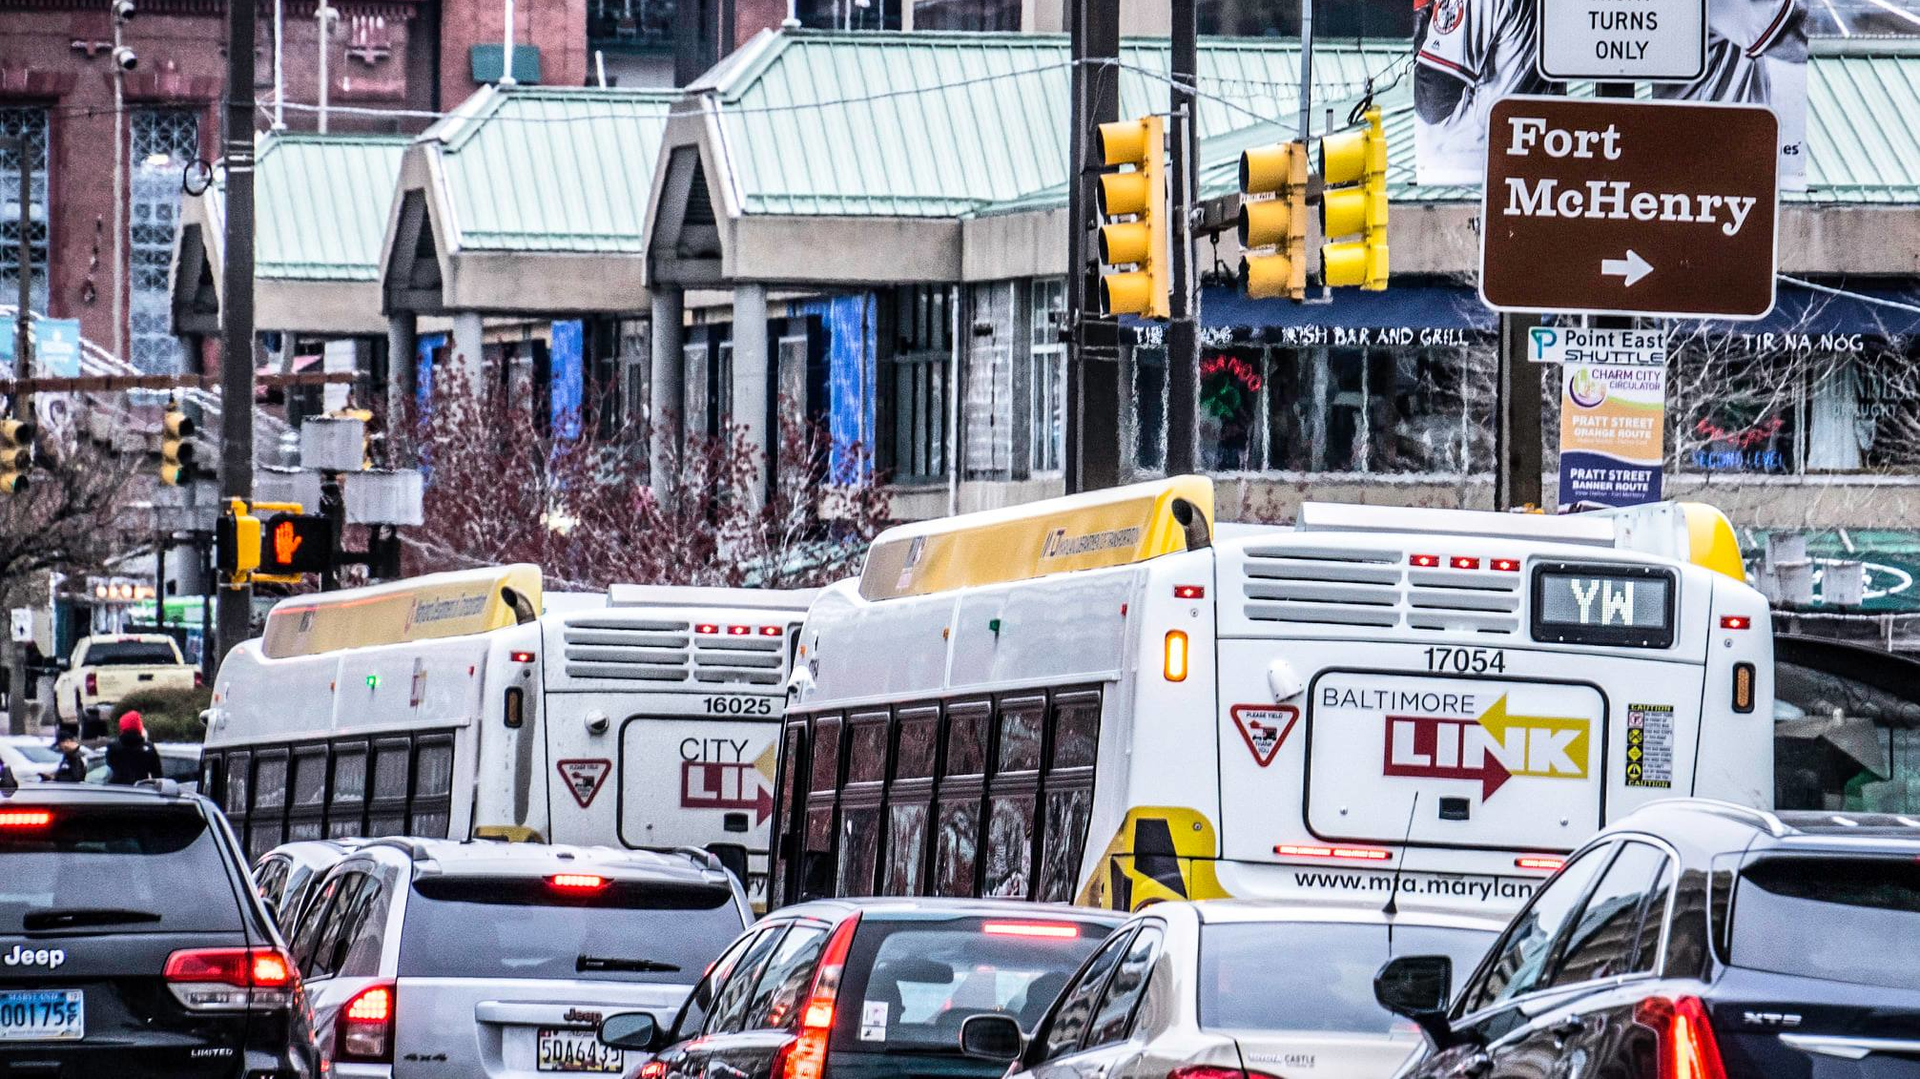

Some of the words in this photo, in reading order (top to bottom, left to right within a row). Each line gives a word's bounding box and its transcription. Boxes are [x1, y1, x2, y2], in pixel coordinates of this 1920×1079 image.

[1588, 11, 1658, 31] TURNS
[1595, 41, 1649, 60] ONLY
[1506, 117, 1622, 161] Fort
[1503, 177, 1757, 237] McHenry
[1334, 326, 1370, 346] BAR
[1376, 327, 1414, 345] AND
[1565, 330, 1615, 347] Point
[1622, 332, 1664, 349] East
[1742, 333, 1775, 351] TIR
[1785, 334, 1811, 351] NA
[1565, 349, 1664, 365] SHUTTLE
[1592, 369, 1633, 380] CHARM
[1635, 371, 1661, 381] CITY
[1572, 416, 1608, 426] PRATT
[1611, 417, 1654, 429] STREET
[1617, 429, 1652, 440] ROUTE
[1570, 468, 1607, 480] PRATT
[1608, 470, 1653, 482] STREET
[1572, 480, 1613, 491] BANNER
[1615, 481, 1649, 492] ROUTE
[1571, 578, 1635, 626] YW
[1424, 647, 1506, 672] 17054
[704, 697, 772, 714] 16025
[1323, 687, 1475, 714] BALTIMORE
[680, 738, 749, 762] CITY
[1391, 720, 1583, 773] LINK
[4, 945, 66, 968] Jeep
[563, 1007, 603, 1027] Jeep
[191, 1049, 233, 1057] LIMITED
[1284, 1055, 1315, 1063] CASTLE
